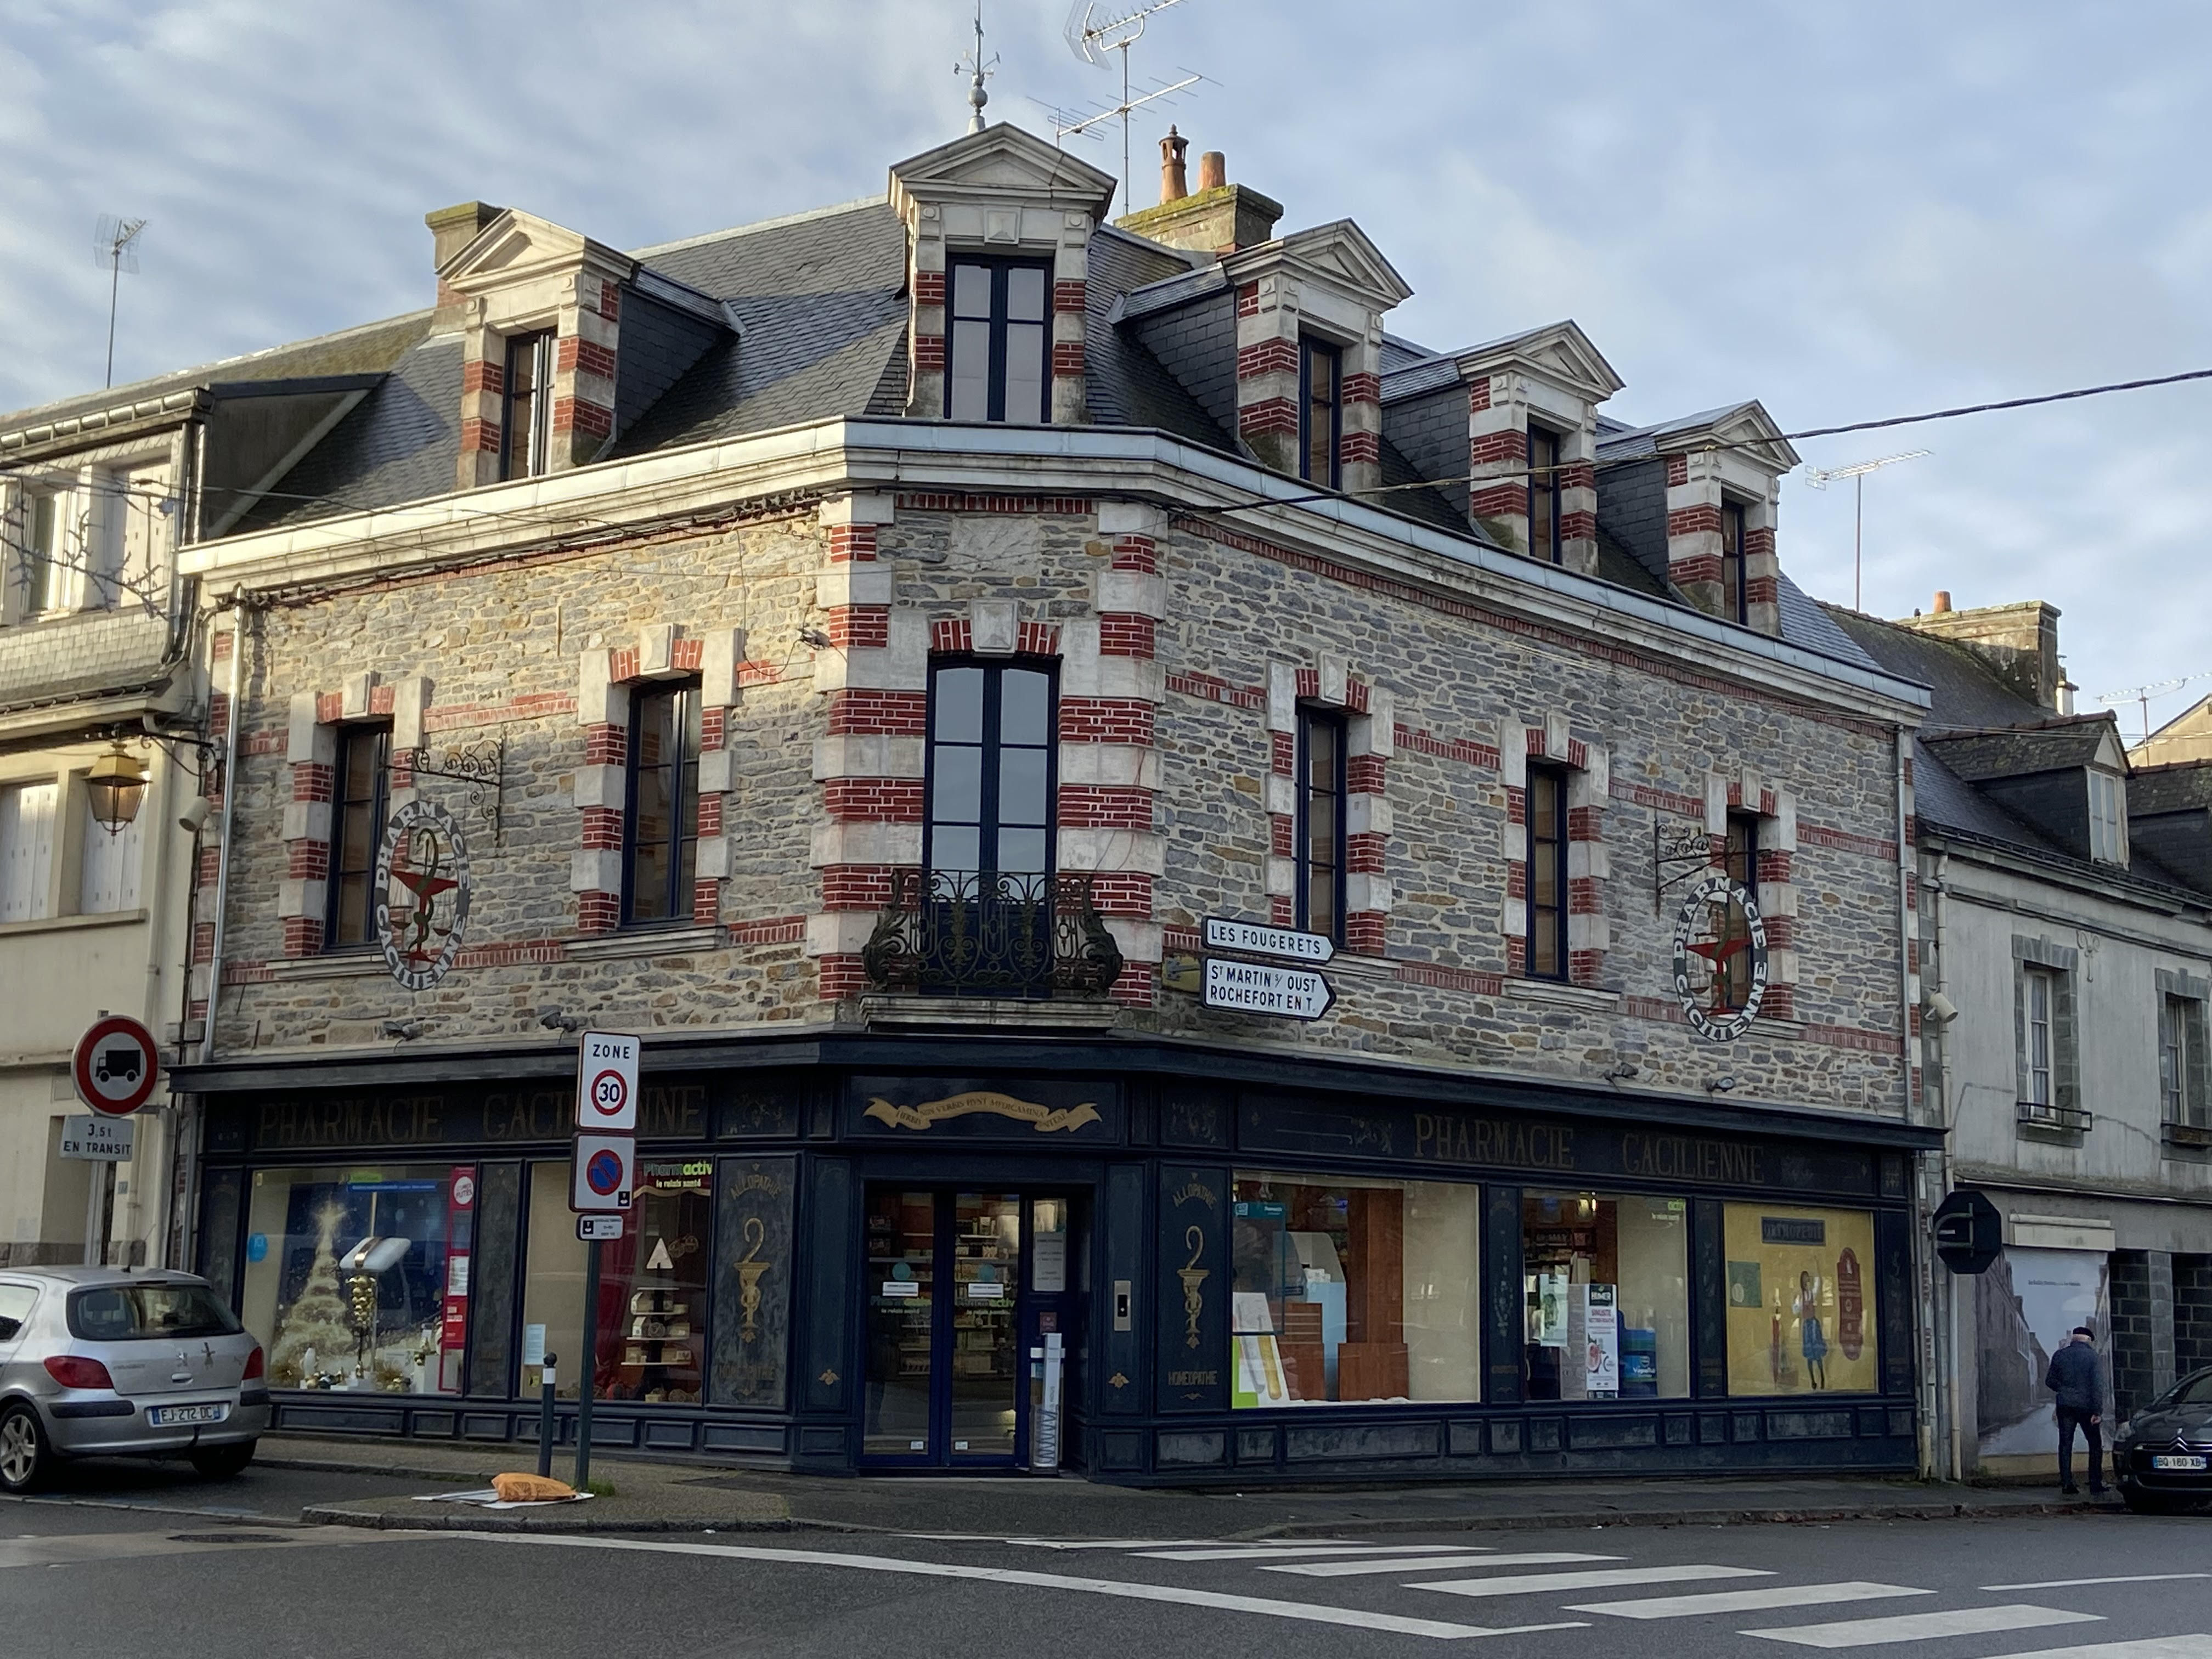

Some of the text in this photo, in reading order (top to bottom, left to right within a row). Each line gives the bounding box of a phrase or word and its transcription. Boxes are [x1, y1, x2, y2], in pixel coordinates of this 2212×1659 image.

[375, 800, 471, 891] PHARMACIE
[1211, 924, 1321, 955] LES FOUGERETS
[1673, 877, 1767, 960] PHARMACIE
[375, 903, 467, 990] GACILIENNE
[1210, 985, 1283, 1008] ROCHEFORT
[1287, 995, 1301, 1011] EN
[1226, 968, 1271, 988] MARTIN
[1287, 975, 1317, 993] OUST
[1675, 961, 1768, 1042] GACILIENNE
[592, 1044, 630, 1059] ZONE
[483, 1085, 706, 1139] GACINNE
[598, 1082, 620, 1103] 30
[258, 1096, 443, 1146] PHARMACIE
[64, 1141, 131, 1155] EN TRANSIT
[1414, 1113, 1765, 1184] PHARMACIE GACILIENNE
